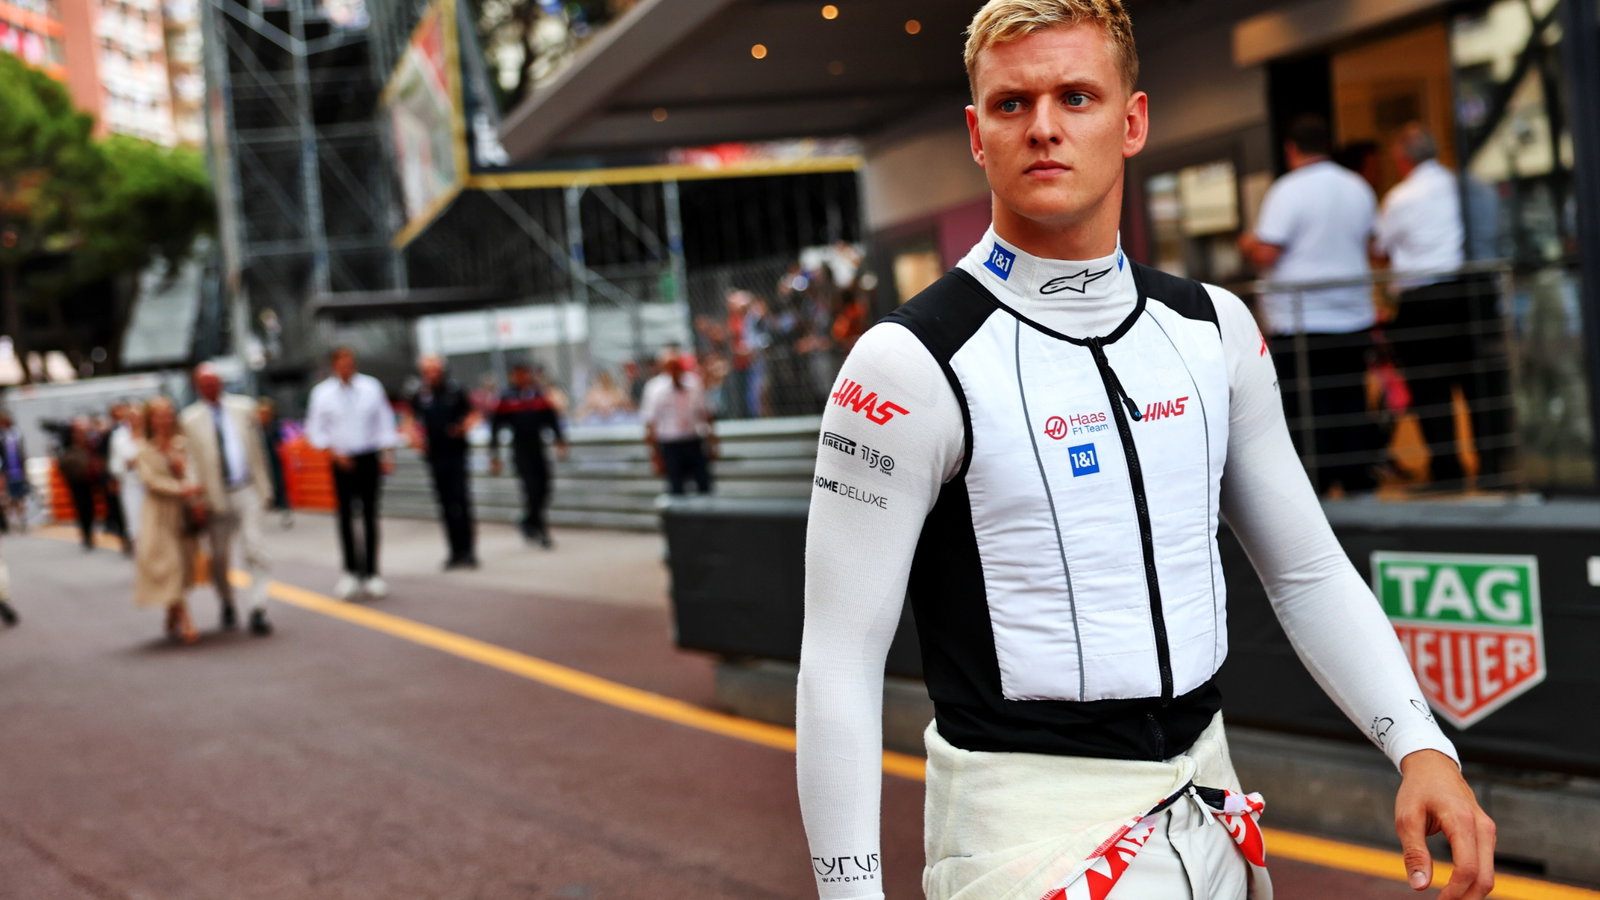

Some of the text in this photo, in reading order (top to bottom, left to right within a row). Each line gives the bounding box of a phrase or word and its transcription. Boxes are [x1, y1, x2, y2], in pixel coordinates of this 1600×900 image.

[991, 248, 1010, 272] 1&1
[832, 378, 910, 426] HAAS
[1142, 396, 1189, 422] HAAS
[1069, 411, 1107, 426] Haas
[1072, 423, 1109, 436] F1 Team
[822, 431, 895, 471] PIRELLI 150
[1071, 450, 1096, 469] 1&1
[1385, 566, 1523, 622] TAG
[822, 874, 875, 883] WATCHES
